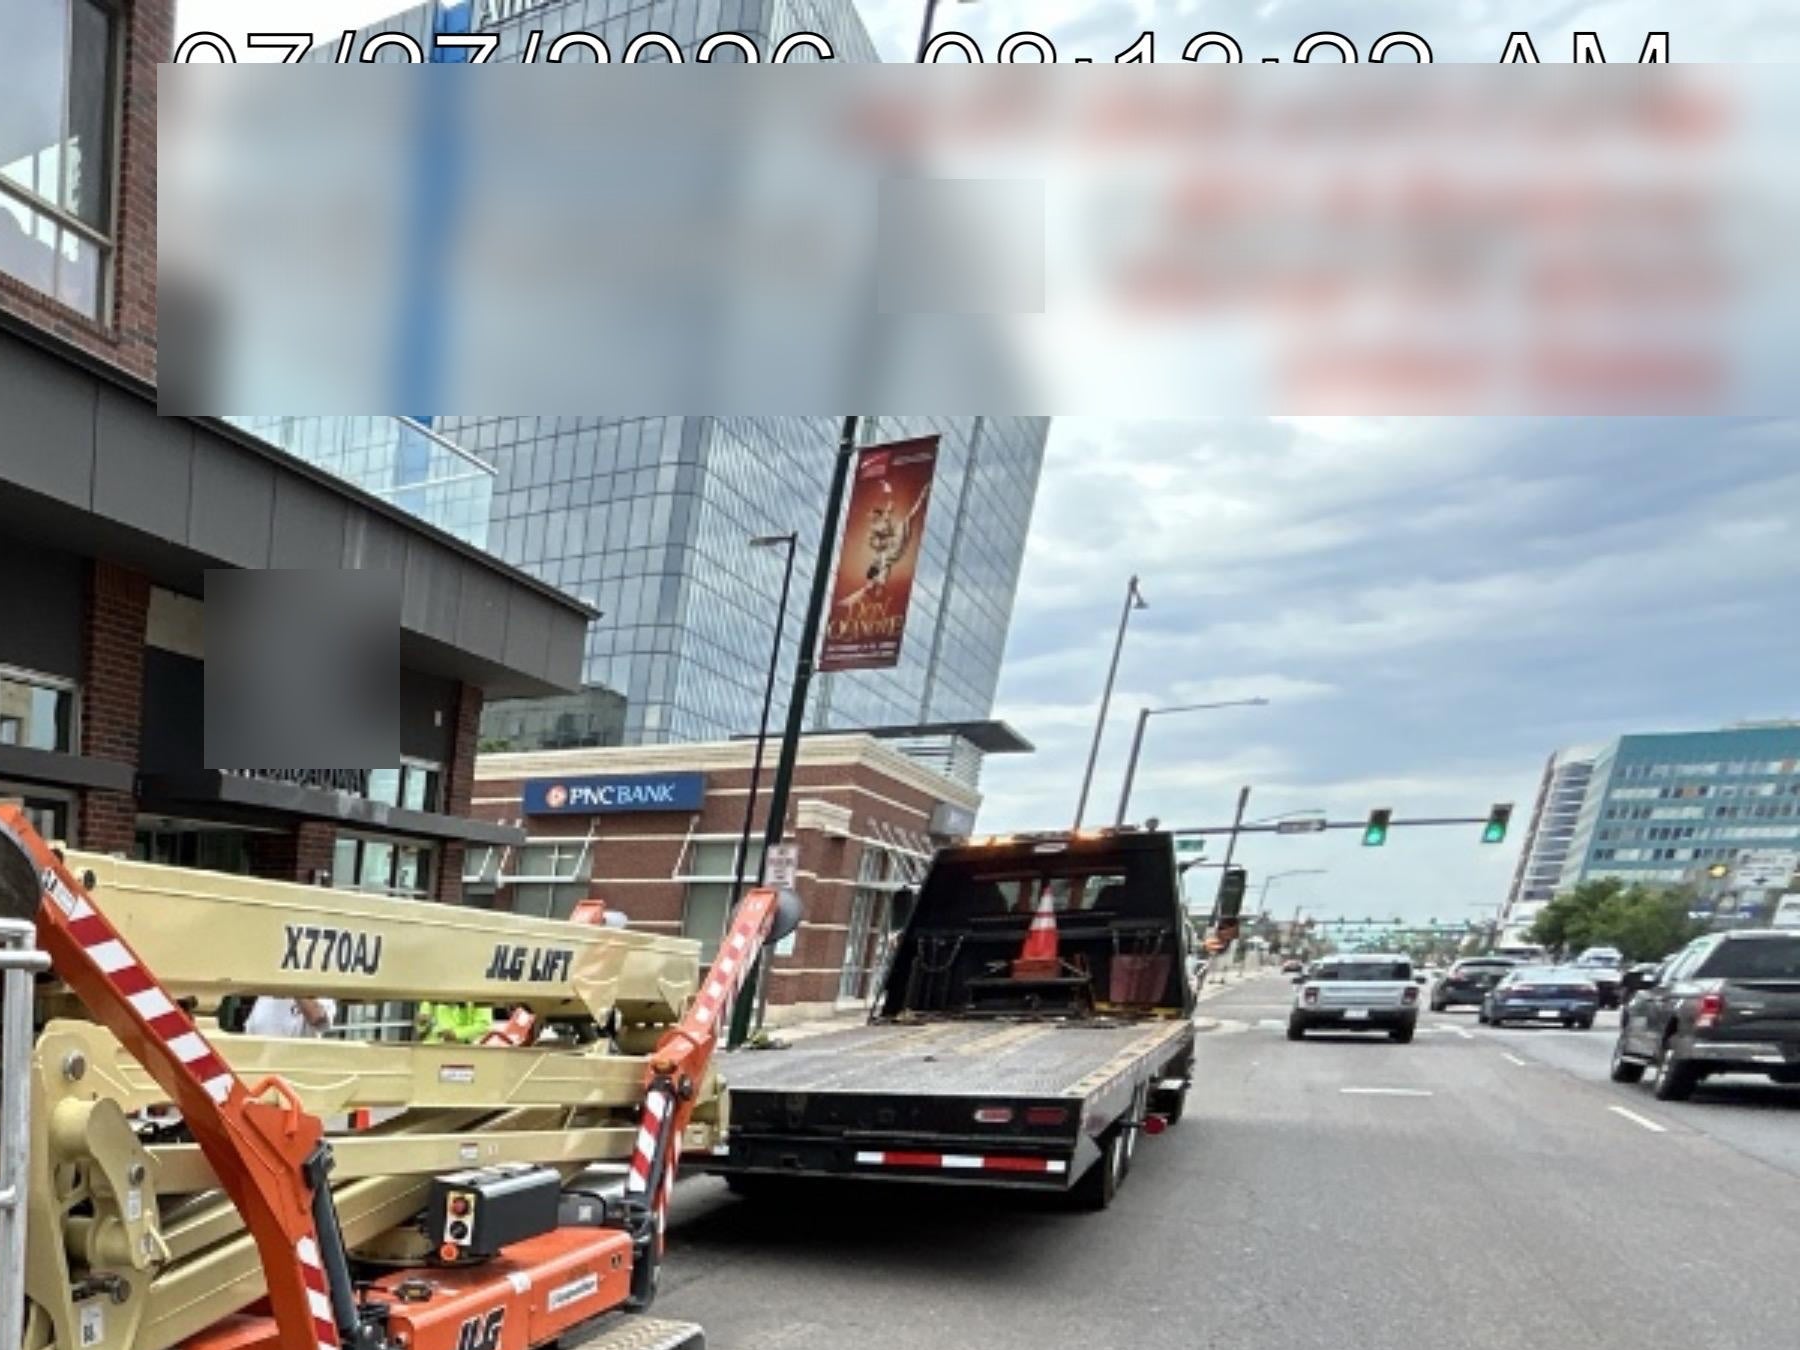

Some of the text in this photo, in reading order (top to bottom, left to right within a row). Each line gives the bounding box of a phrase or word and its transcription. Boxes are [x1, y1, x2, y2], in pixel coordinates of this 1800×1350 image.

[569, 782, 676, 805] PNC BANK
[281, 924, 382, 975] X770AJ
[486, 945, 575, 982] JLG LIFT
